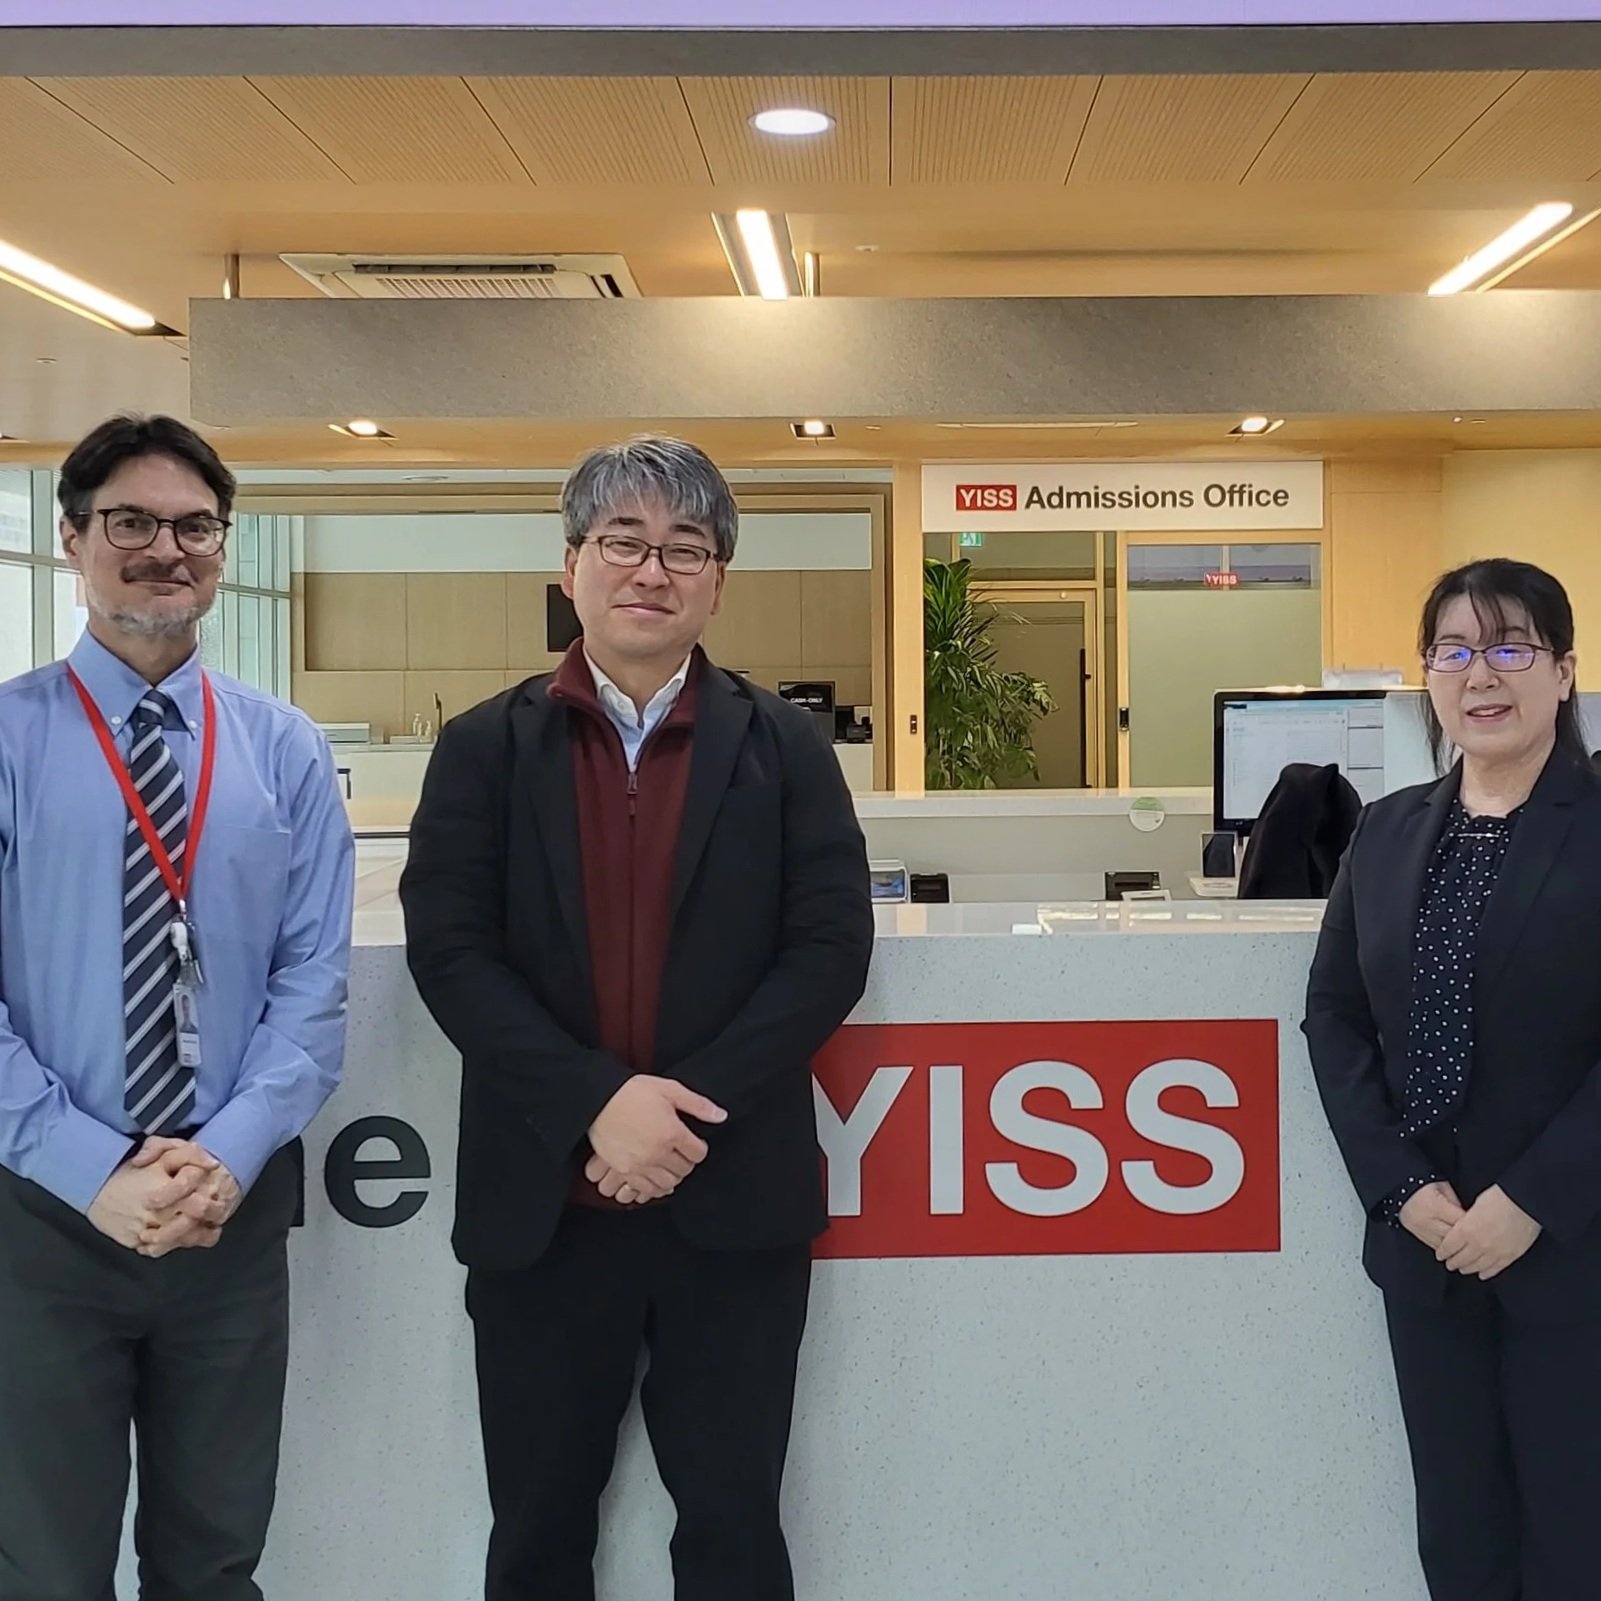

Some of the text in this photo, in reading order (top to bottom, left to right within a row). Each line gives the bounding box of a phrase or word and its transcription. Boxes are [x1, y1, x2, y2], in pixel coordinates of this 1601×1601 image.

[960, 483, 1290, 509] YISS Admissions Office
[811, 1058, 1245, 1217] YISS
